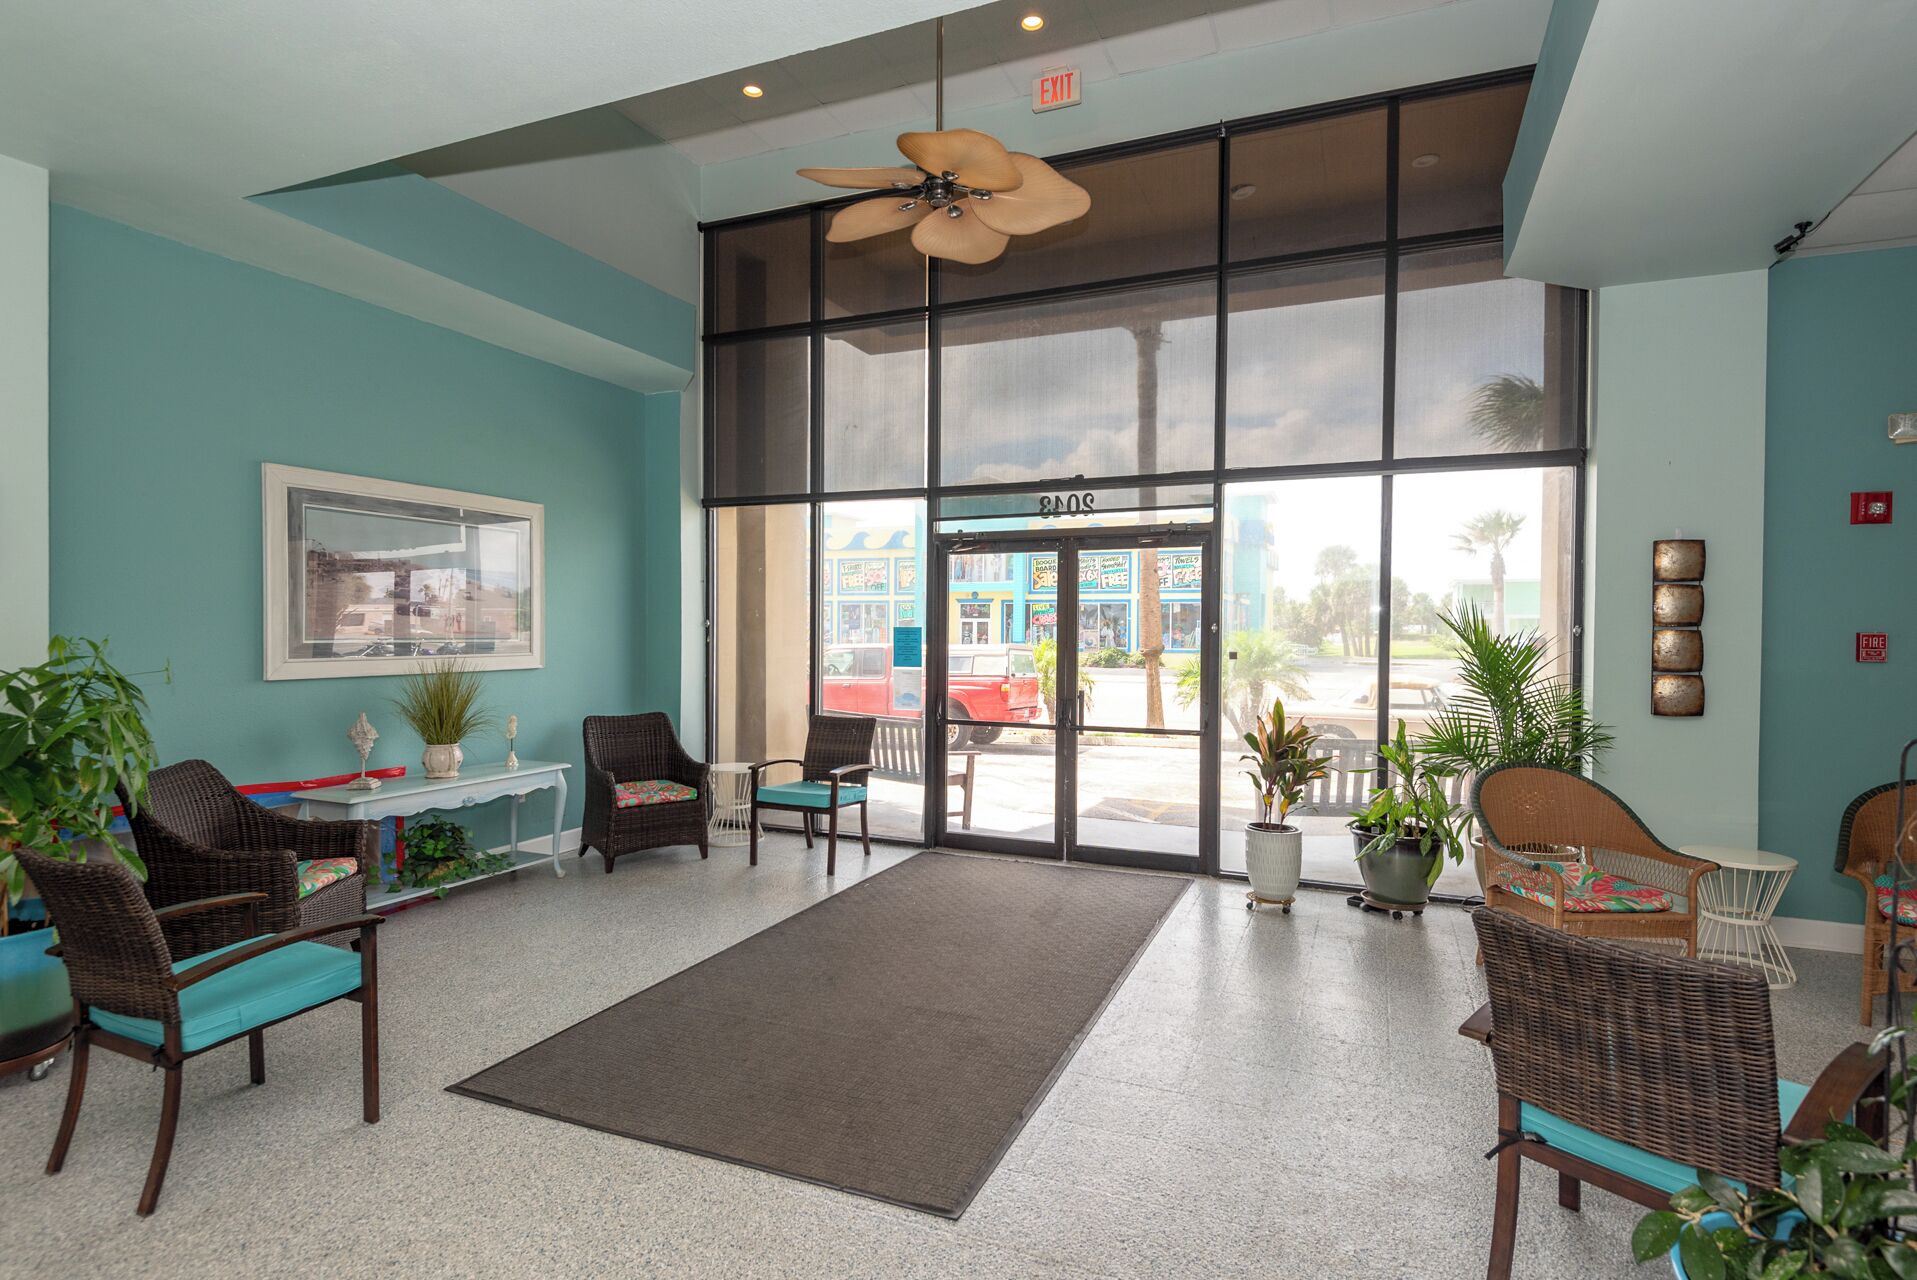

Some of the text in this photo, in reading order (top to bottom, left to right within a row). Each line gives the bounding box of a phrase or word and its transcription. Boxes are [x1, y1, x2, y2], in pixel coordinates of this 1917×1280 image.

[1040, 72, 1074, 105] EXIT
[1035, 565, 1057, 573] BOARD
[1174, 568, 1202, 585] FREE
[1033, 571, 1058, 590] Sale
[1101, 572, 1128, 589] FREE
[1862, 637, 1885, 648] FIRE
